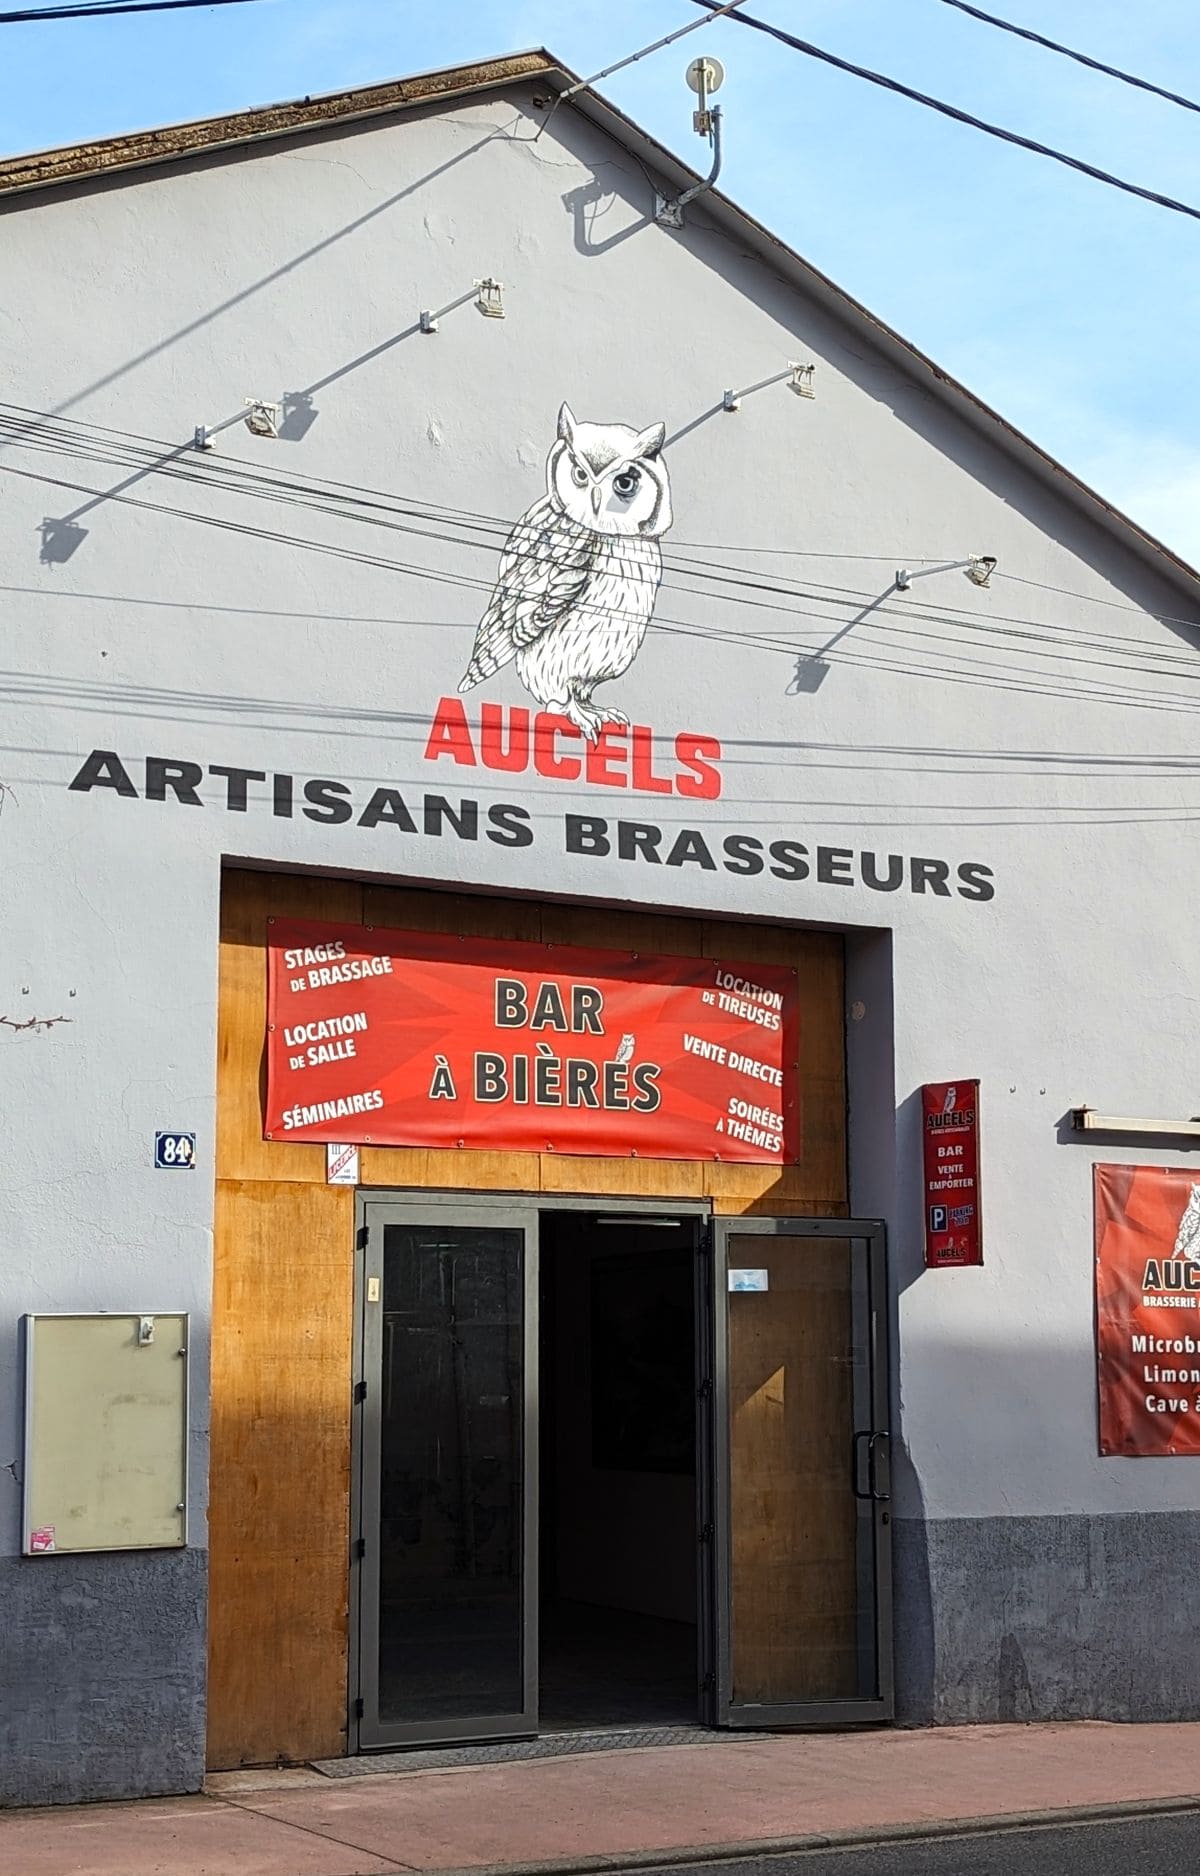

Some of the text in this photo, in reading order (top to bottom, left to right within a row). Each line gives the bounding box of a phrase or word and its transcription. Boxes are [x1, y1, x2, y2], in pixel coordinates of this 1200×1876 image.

[424, 697, 721, 800] AUCELS
[68, 749, 995, 901] ARTISANS BRASSEURS
[284, 941, 346, 969] STAGES
[290, 956, 393, 992] DE BRASSAGE
[715, 970, 784, 1011] LOCATION
[495, 978, 605, 1035] BAR
[702, 991, 780, 1031] DE TIREUSES
[284, 1012, 368, 1047] LOCATION
[289, 1039, 356, 1070] DE SALLE
[684, 1033, 784, 1087] VENTE DIRECTE
[429, 1043, 662, 1112] À BIÈRES
[282, 1090, 384, 1130] SÉMINAIRES
[728, 1097, 784, 1133] SOIRÉES
[927, 1109, 975, 1128] AUCELS
[727, 1119, 781, 1153] THÈMES
[937, 1145, 963, 1157] BAR
[929, 1178, 974, 1190] EMPORTER
[938, 1164, 963, 1174] VENTE
[934, 1208, 944, 1229] P
[1143, 1296, 1196, 1308] BRASSERIE
[1144, 1365, 1200, 1383] Limon
[1145, 1395, 1189, 1413] Cave
